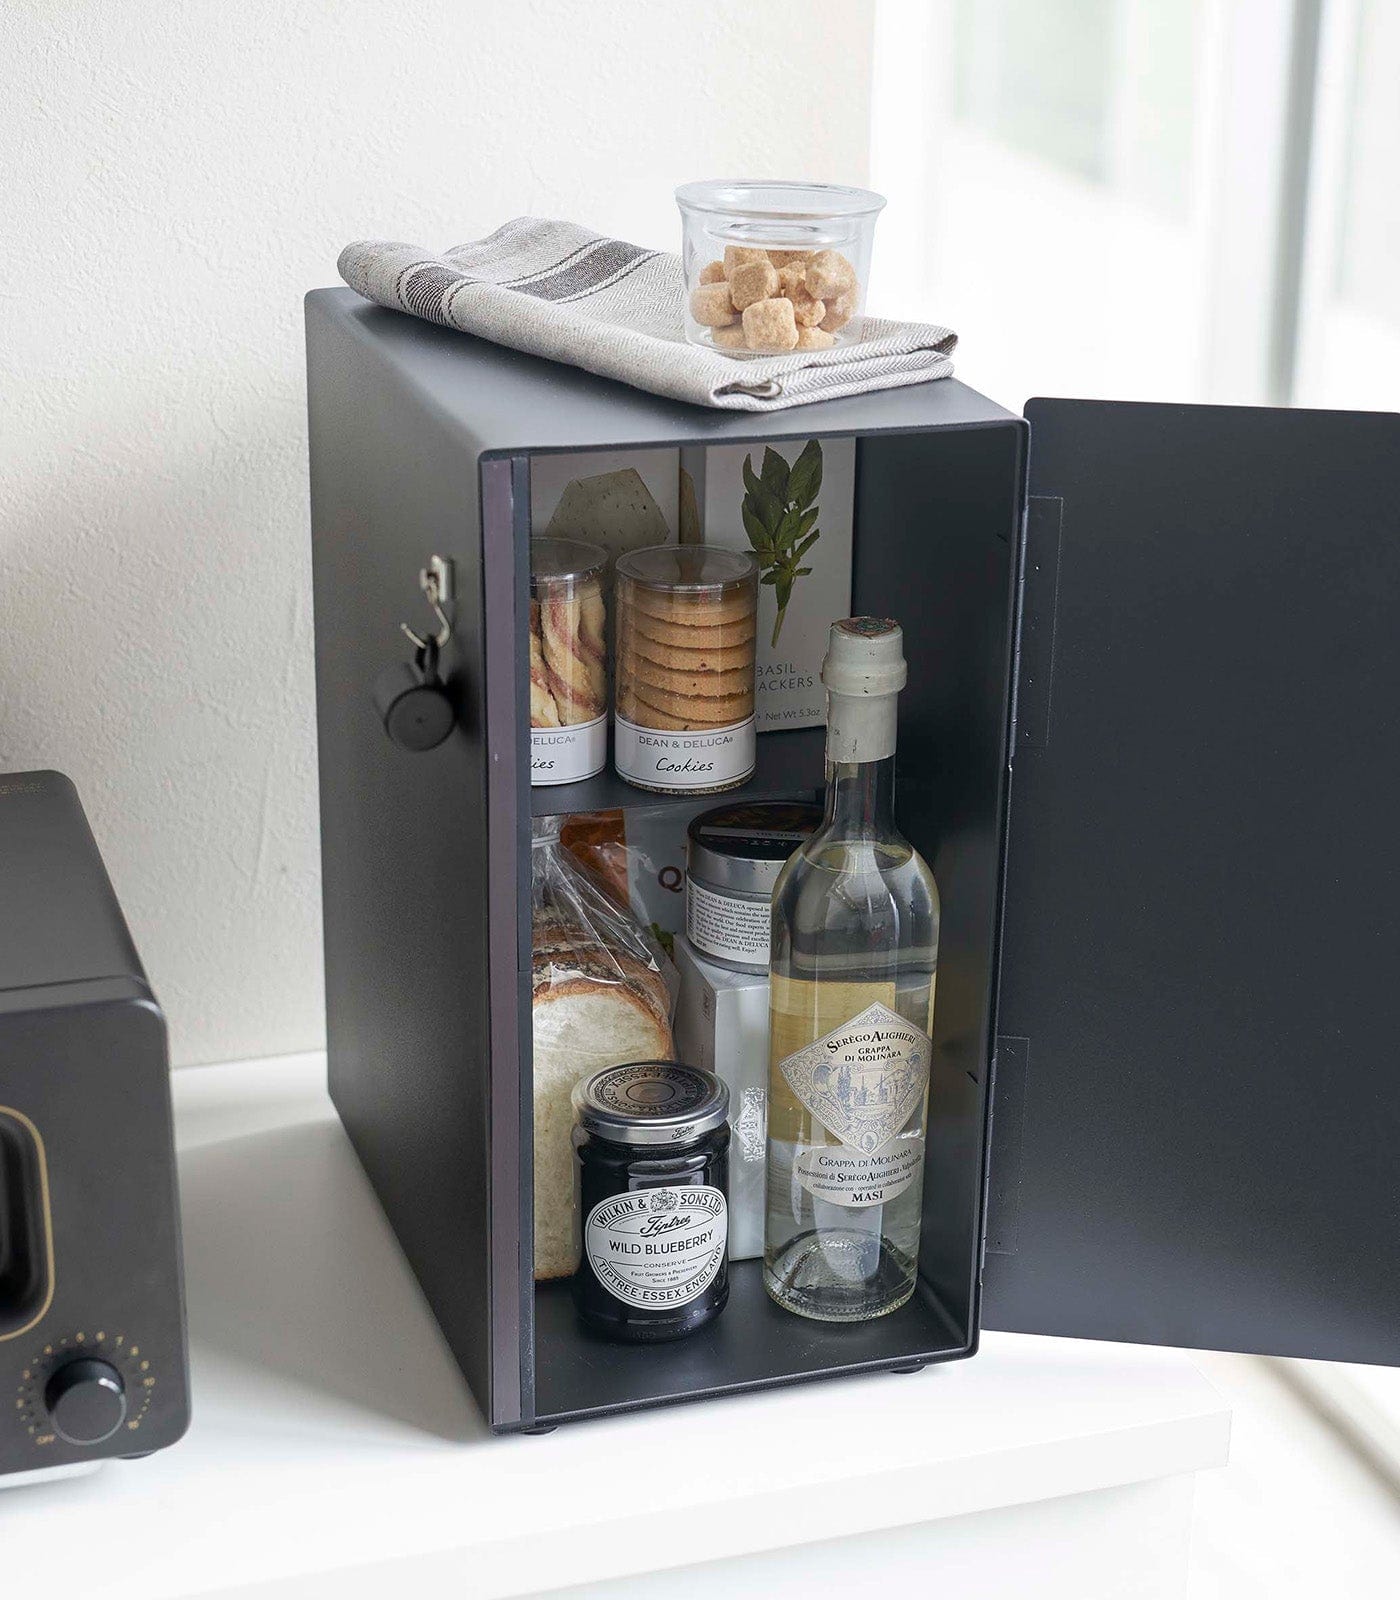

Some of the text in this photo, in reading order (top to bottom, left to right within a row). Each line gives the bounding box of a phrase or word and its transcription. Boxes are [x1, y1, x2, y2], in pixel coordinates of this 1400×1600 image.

[757, 663, 796, 676] BASIL
[758, 676, 813, 691] ACKERS
[766, 712, 780, 720] Net
[783, 710, 797, 719] Wt
[639, 735, 669, 748] DEAN
[671, 740, 680, 748] &
[531, 757, 555, 769] ies
[655, 757, 714, 772] Cookies
[658, 866, 683, 893] Q
[724, 901, 745, 910] DELUCA
[870, 1031, 916, 1044] ALIGHIERI
[857, 1050, 901, 1062] MOLINARA
[858, 1045, 891, 1054] GRAPPA
[819, 1156, 855, 1167] GRAPPA
[870, 1149, 912, 1166] MOLINARA
[851, 1190, 884, 1202] MASI
[596, 1201, 634, 1225] WILKIN
[638, 1198, 647, 1209] &
[680, 1193, 709, 1206] SONS
[708, 1196, 724, 1213] LTD
[640, 1215, 691, 1238] Tiptree
[609, 1229, 714, 1254] WILD BLUEBERRY
[643, 1259, 686, 1268] CONSERVE
[599, 1247, 721, 1300] TIPTREE ESSEX ENGLAND
